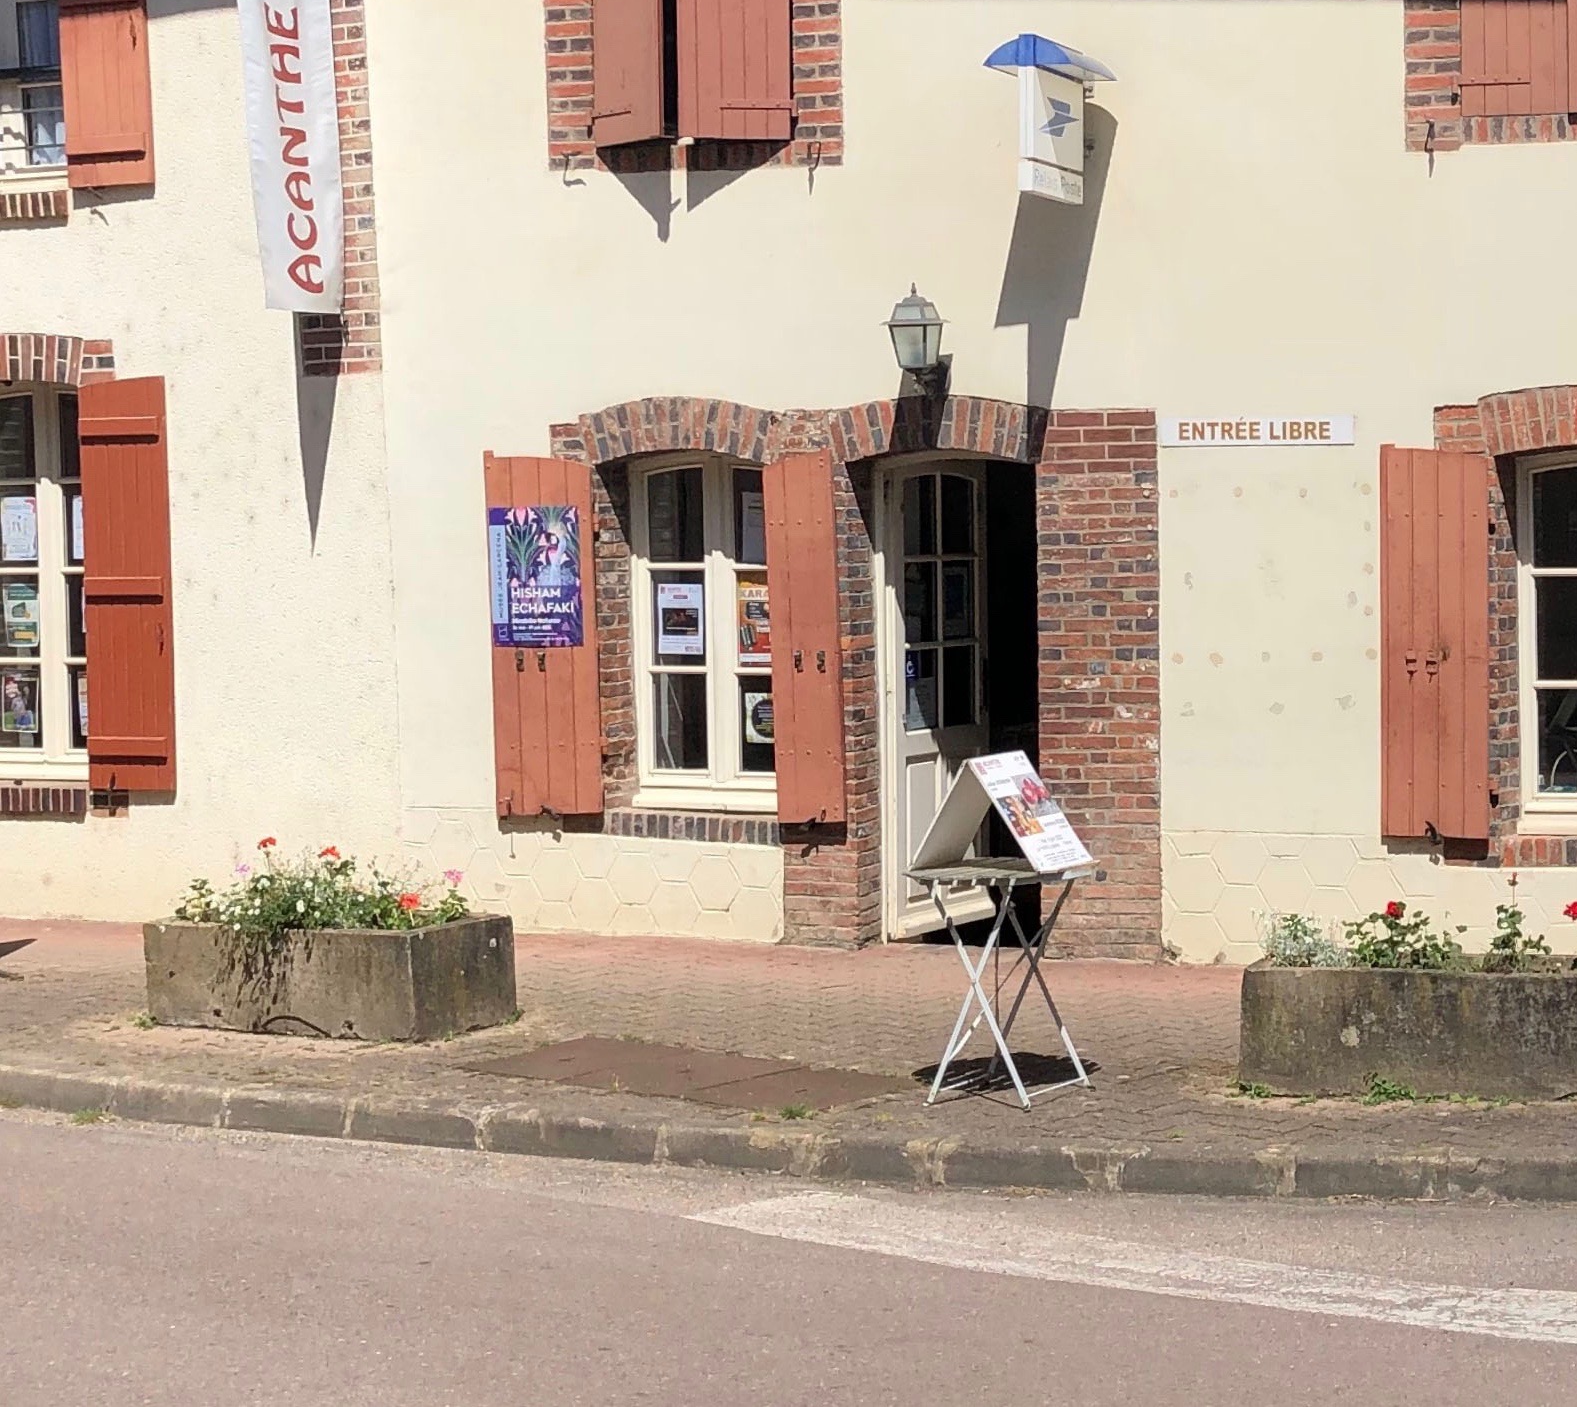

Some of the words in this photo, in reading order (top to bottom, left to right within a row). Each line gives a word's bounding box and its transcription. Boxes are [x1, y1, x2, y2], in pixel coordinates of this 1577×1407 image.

[263, 2, 325, 294] ACANTHE
[1178, 416, 1261, 440] ENTRÉE
[1269, 421, 1331, 440] LIBRE
[511, 587, 561, 598] HISHAM
[512, 602, 575, 614] ECHAFAKI
